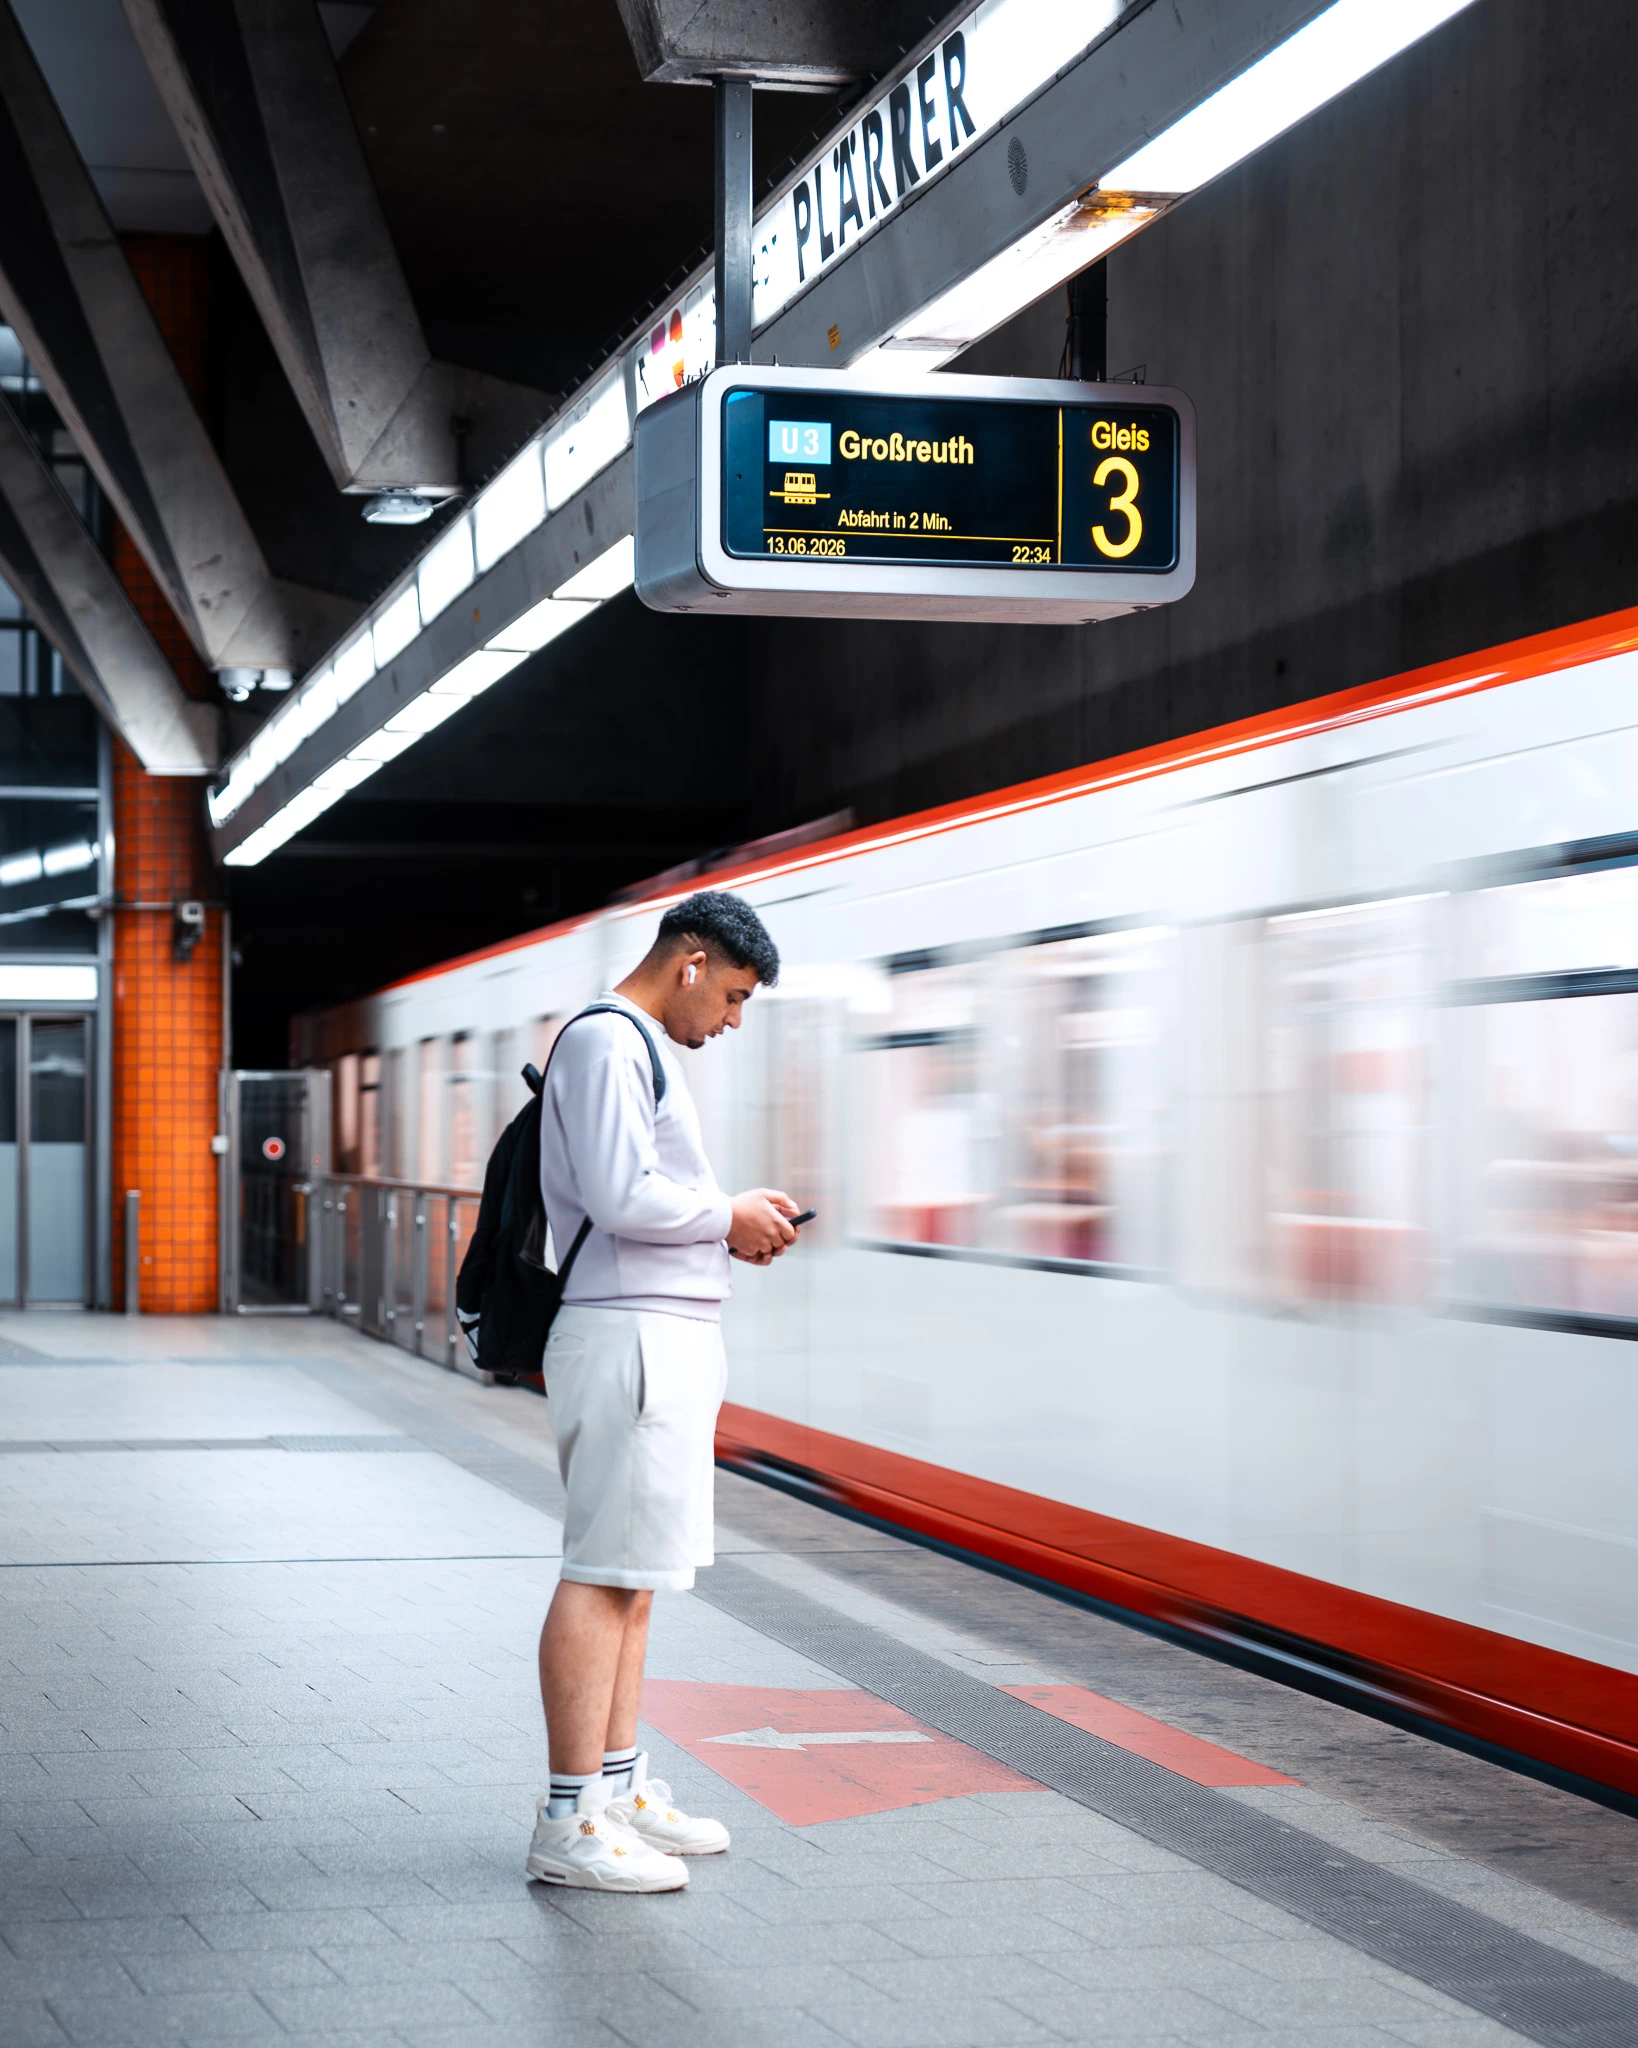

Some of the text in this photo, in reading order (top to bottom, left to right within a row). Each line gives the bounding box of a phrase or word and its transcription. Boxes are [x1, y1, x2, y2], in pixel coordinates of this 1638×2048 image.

[793, 30, 977, 283] PLÄRRER
[839, 430, 974, 465] Großreuth
[1091, 420, 1150, 452] Gleis
[837, 509, 953, 531] Abfahrt in 2 Min.
[1091, 456, 1143, 559] 3
[766, 536, 846, 556] 13.06.2026
[1011, 545, 1052, 564] 22:34
